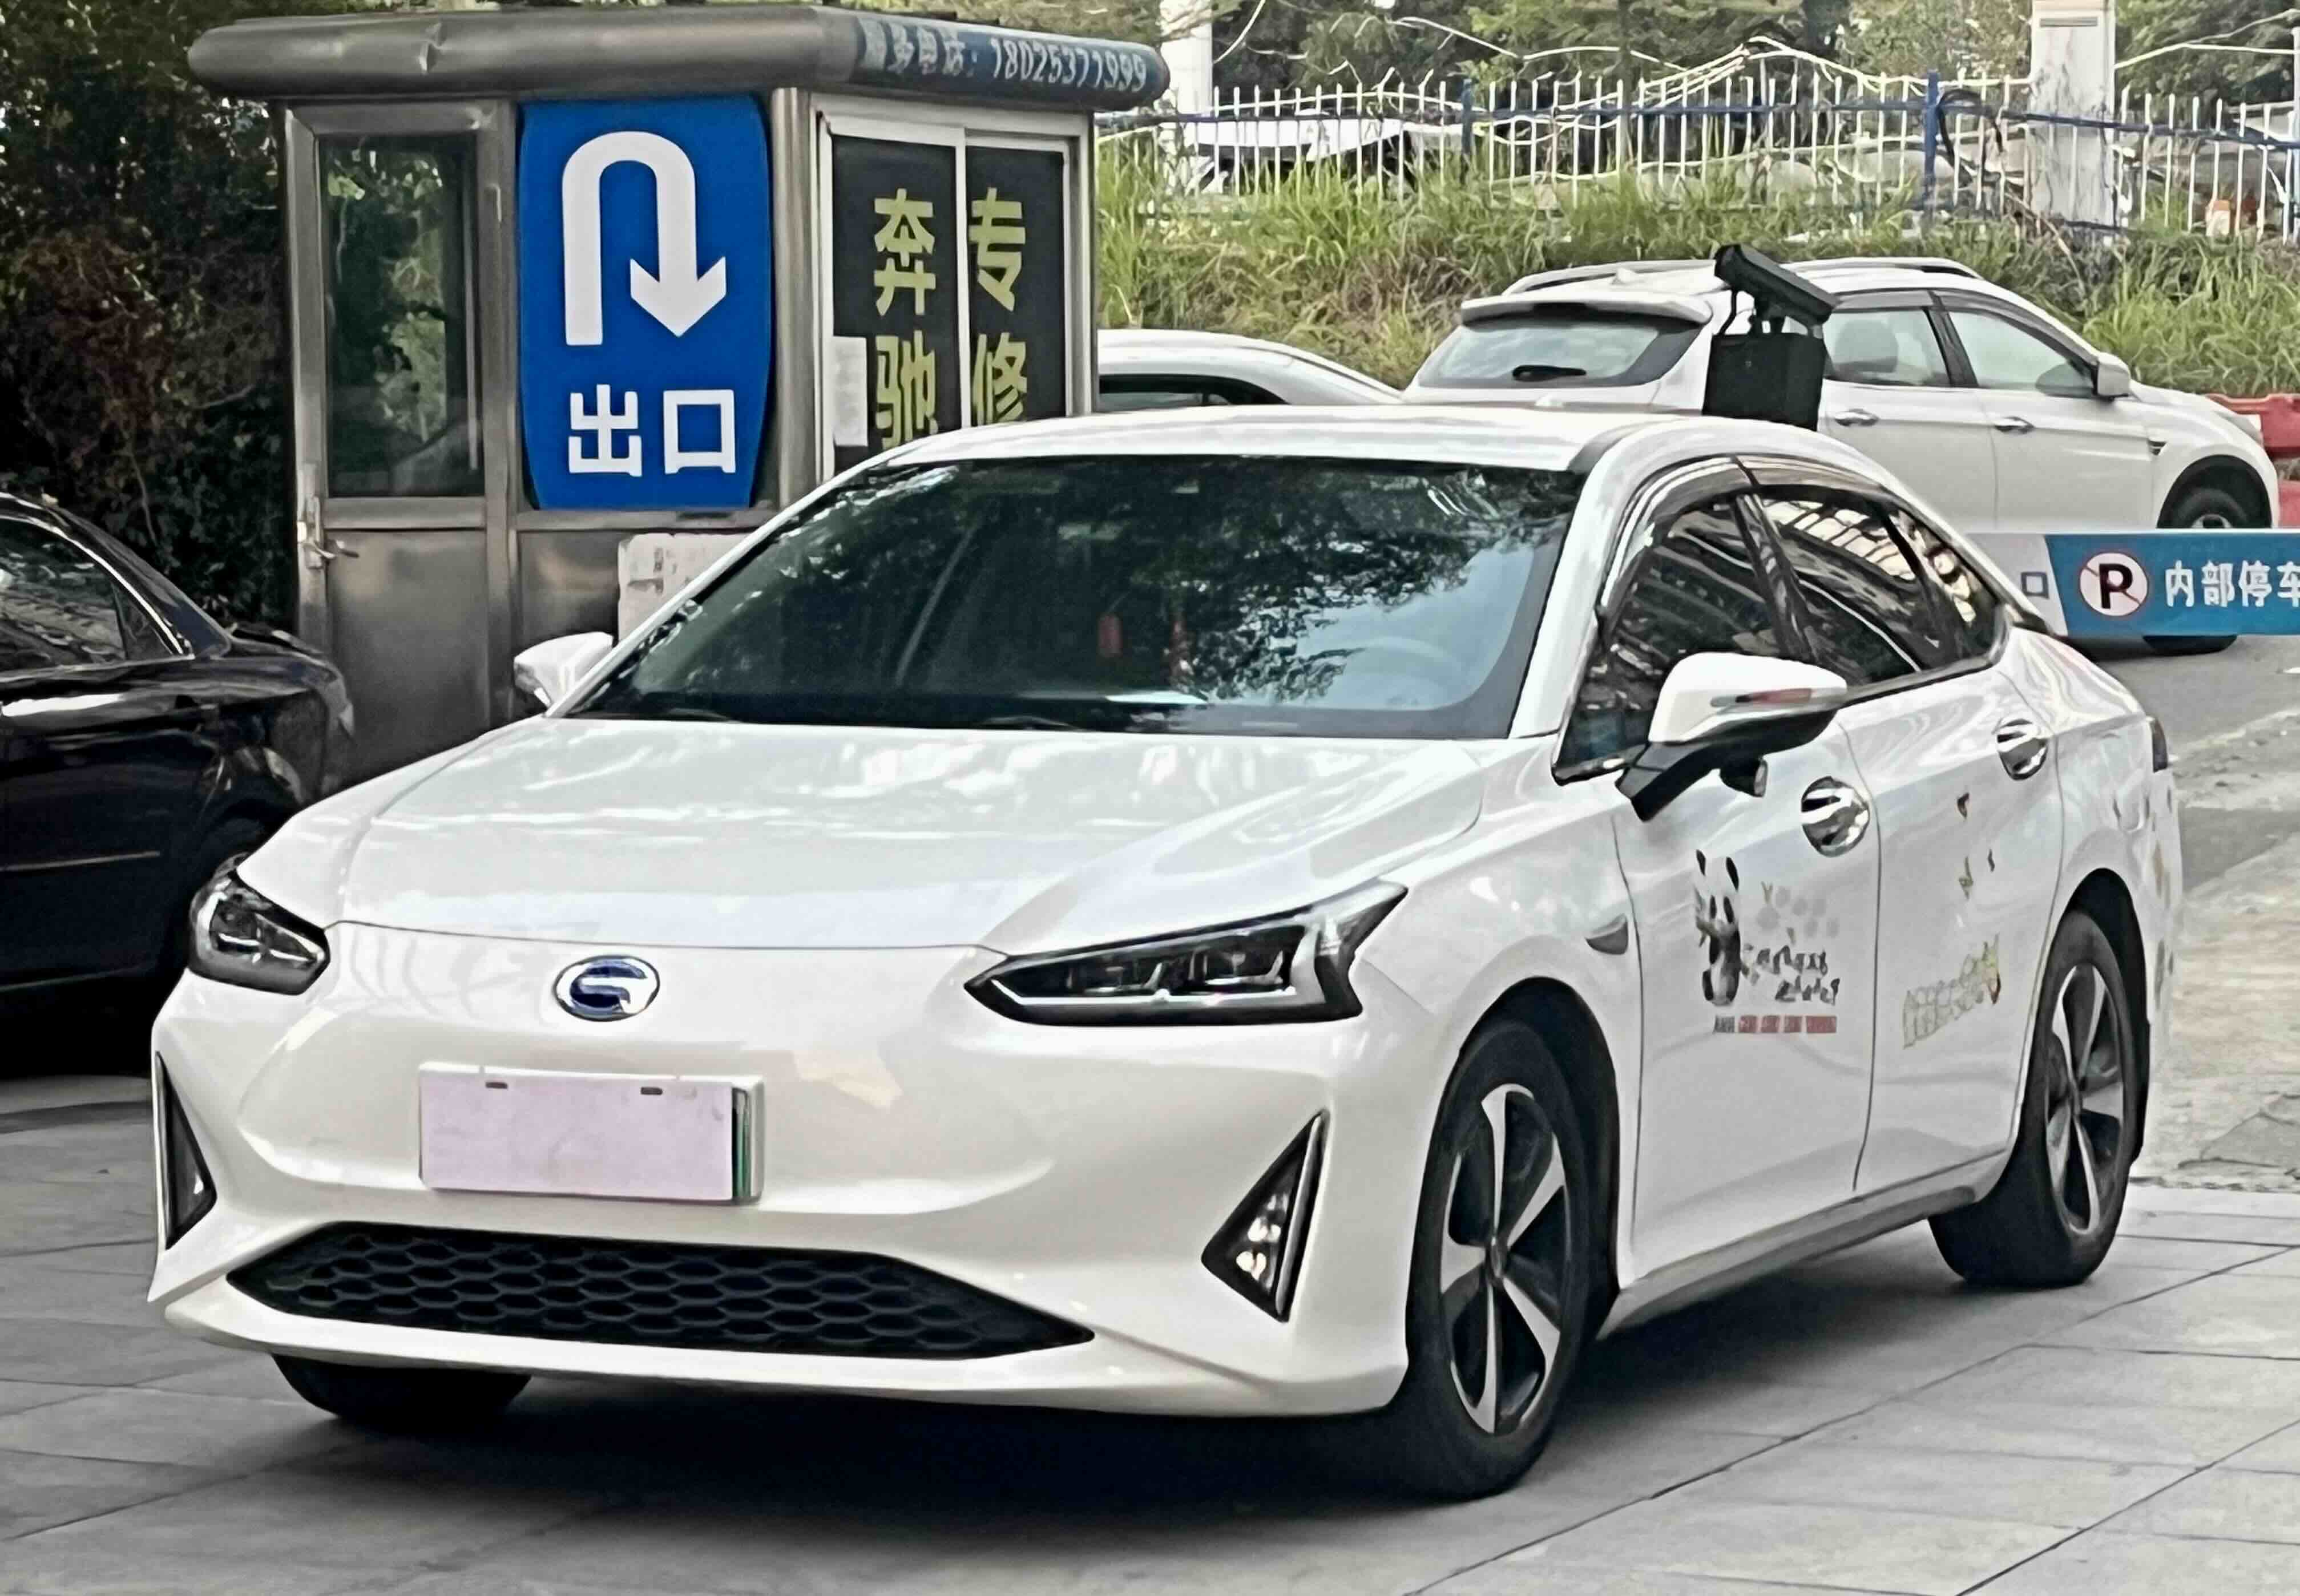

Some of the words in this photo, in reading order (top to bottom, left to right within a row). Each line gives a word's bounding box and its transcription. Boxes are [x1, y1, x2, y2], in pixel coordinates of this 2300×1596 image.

[874, 188, 938, 450] 奔驰
[969, 187, 1027, 426] 专修
[568, 384, 736, 477] 出口
[2099, 563, 2133, 609] P
[2165, 560, 2300, 608] 内部停车
